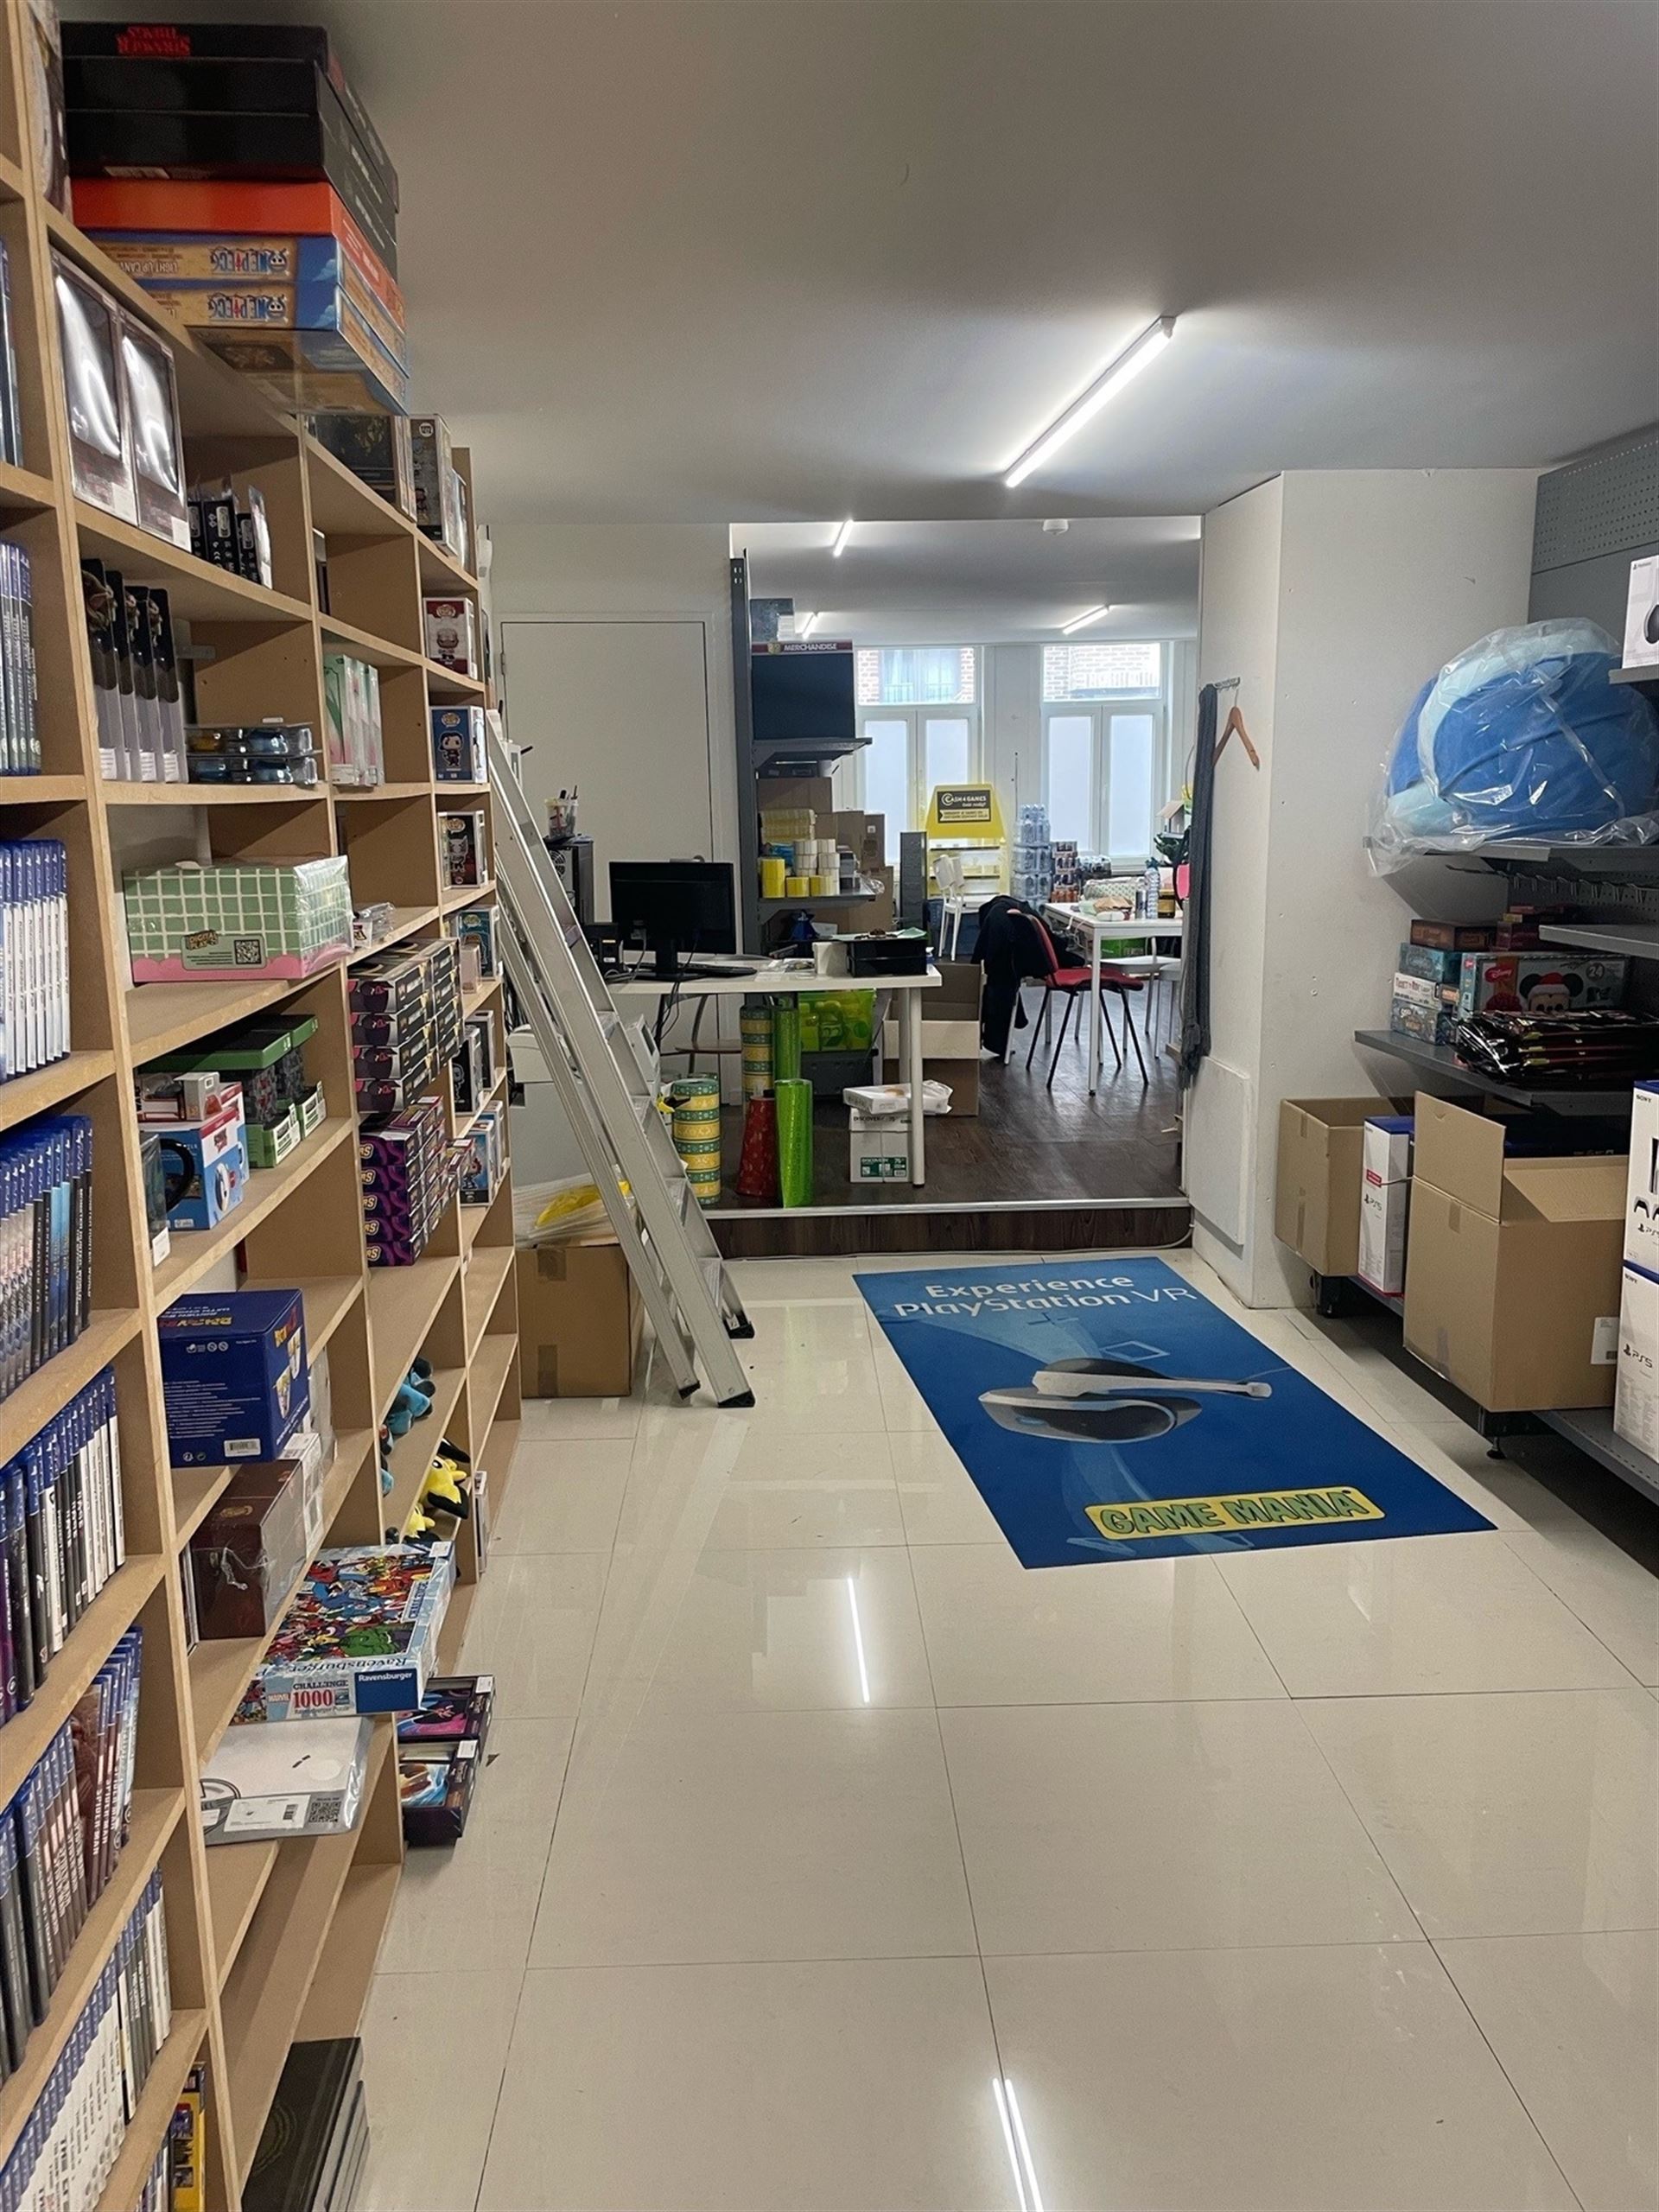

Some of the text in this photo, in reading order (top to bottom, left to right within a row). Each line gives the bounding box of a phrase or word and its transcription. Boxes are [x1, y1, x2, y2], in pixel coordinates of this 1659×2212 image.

[784, 642, 837, 652] MERCHANDISE
[1588, 965, 1604, 977] 24
[1636, 1094, 1652, 1103] SONY
[1370, 1199, 1382, 1211] PS5
[925, 1275, 1135, 1298] Experience
[894, 1287, 1198, 1318] PlayStation VR
[1632, 1350, 1653, 1369] PS5
[1100, 1491, 1371, 1535] GAME MANIA
[289, 1657, 407, 1674] Ravensburger
[358, 1672, 413, 1683] Ravensburger
[293, 1680, 349, 1690] CHALLENGE
[292, 1689, 334, 1709] 1000
